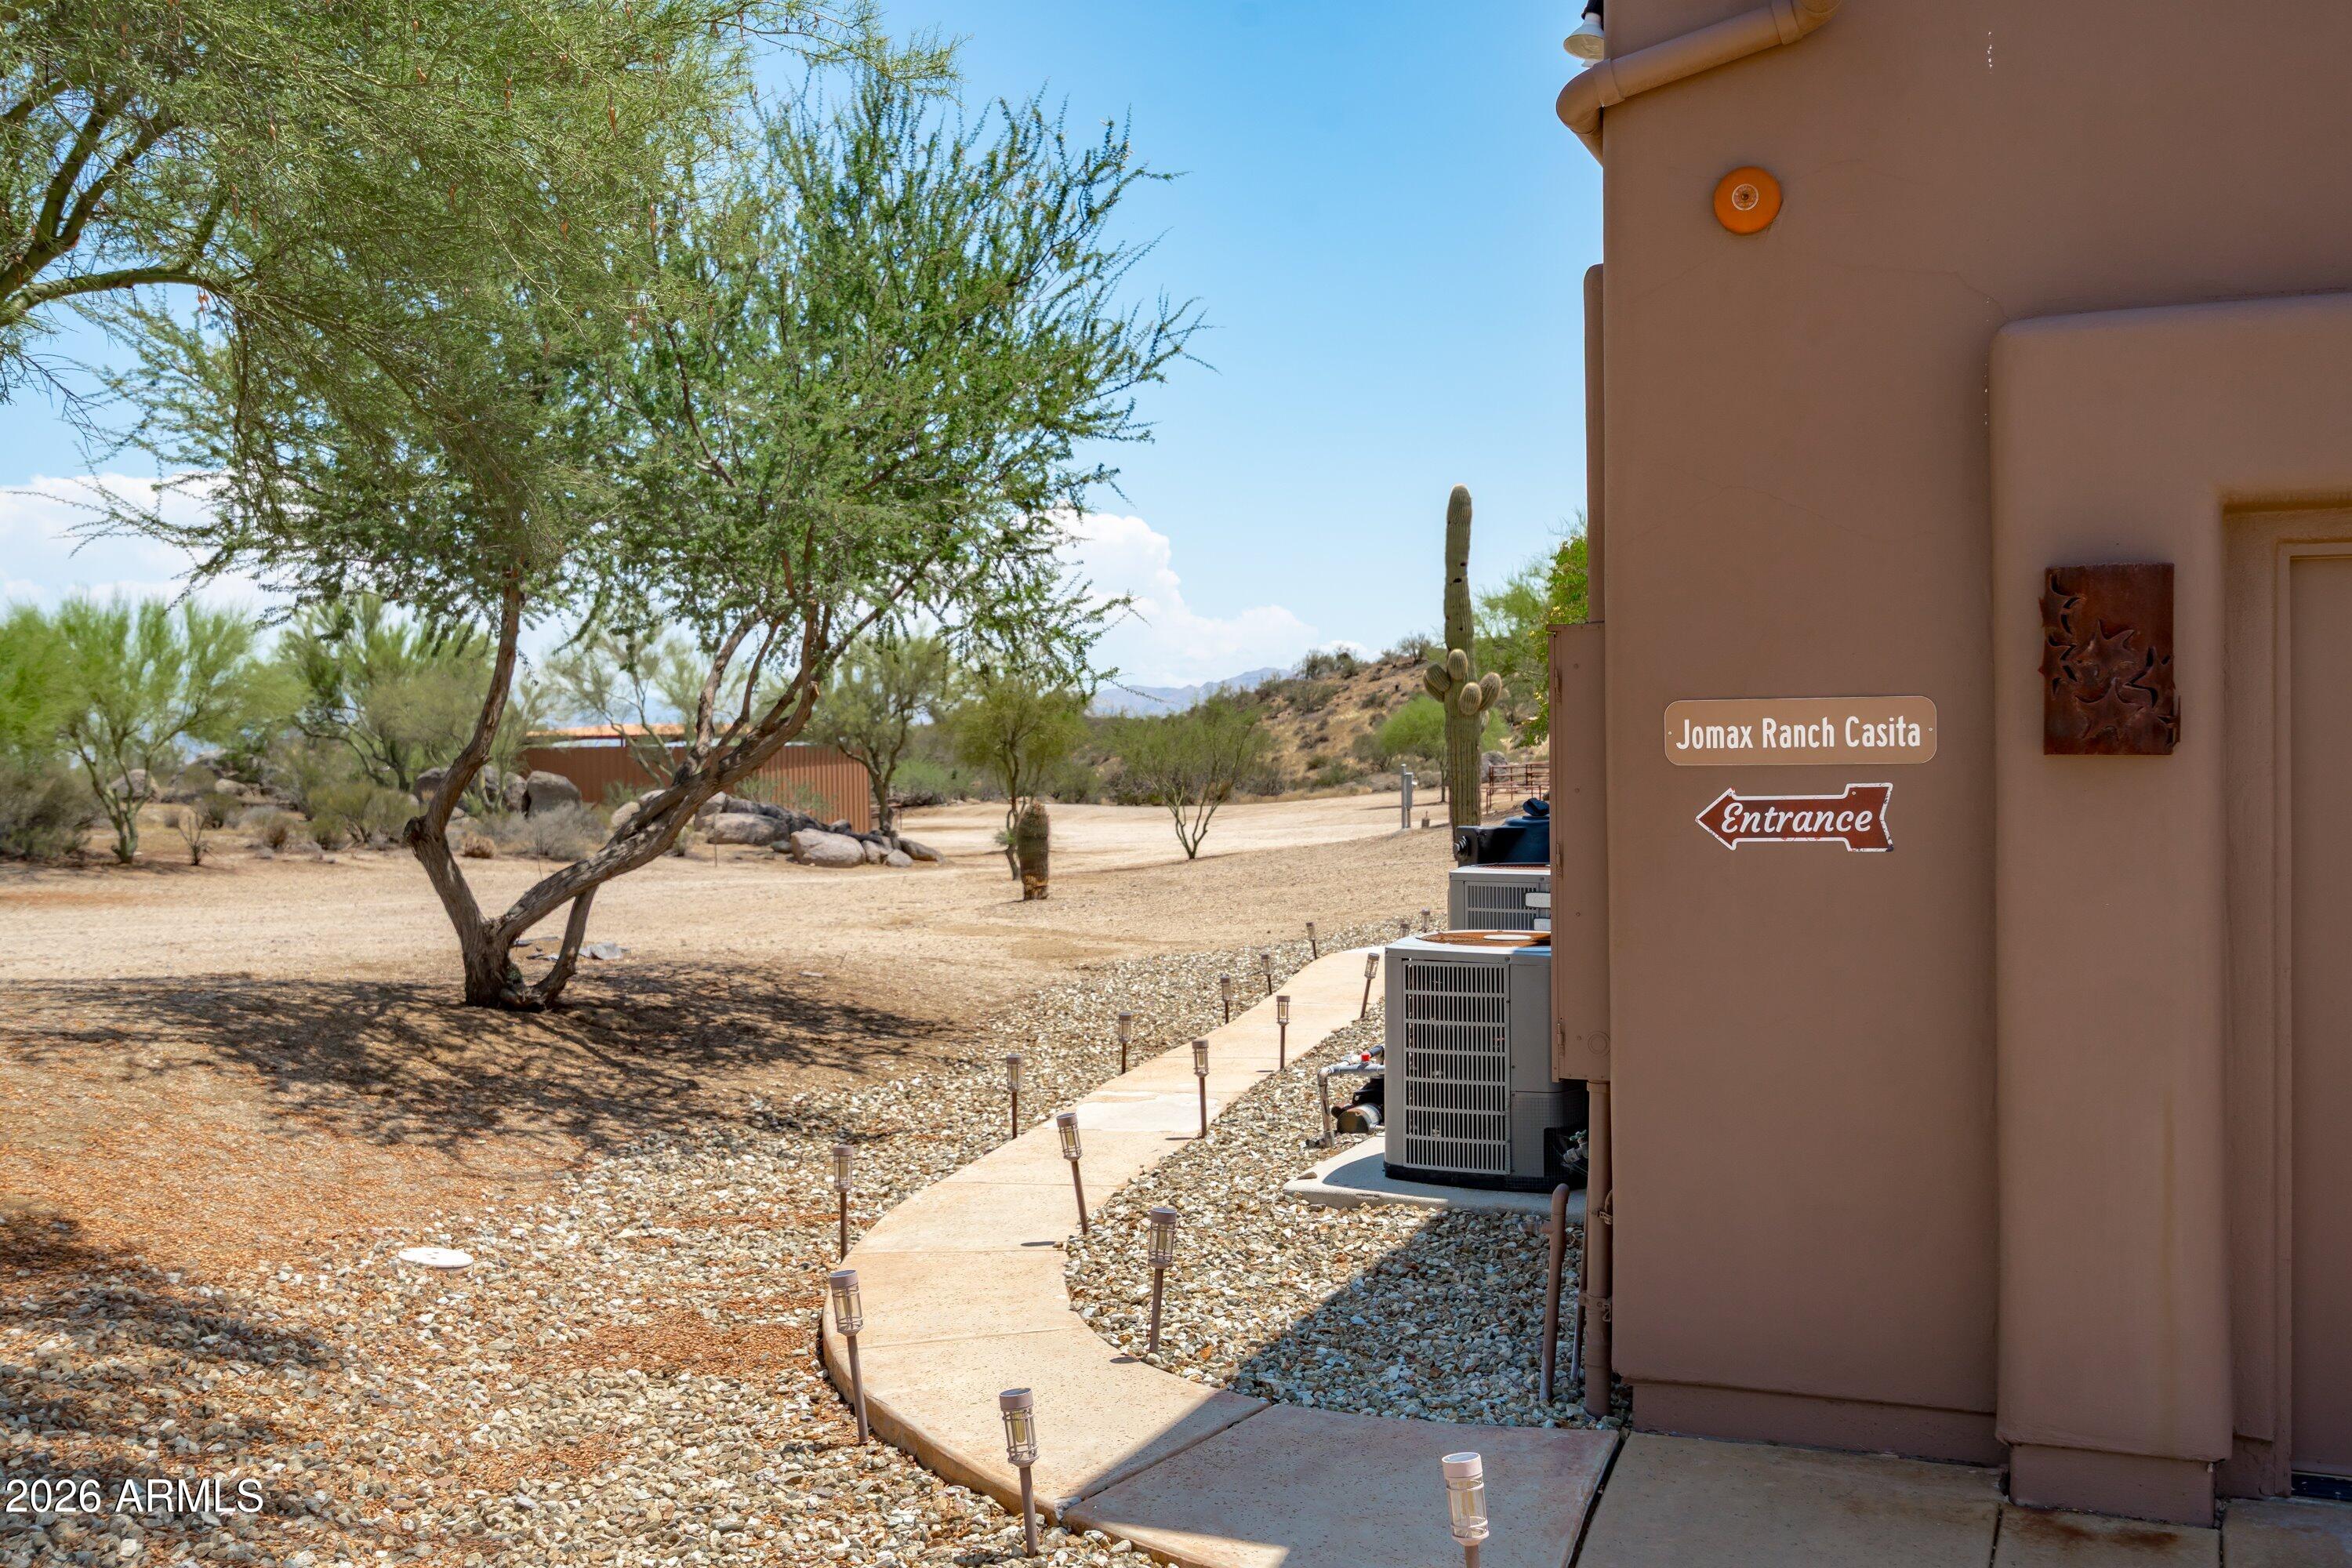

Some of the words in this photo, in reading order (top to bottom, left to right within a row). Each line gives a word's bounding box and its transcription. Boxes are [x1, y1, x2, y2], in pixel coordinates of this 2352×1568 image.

[1675, 719, 1753, 750] Jomax
[1762, 717, 1835, 748] Ranch
[1846, 716, 1921, 748] Casita
[1721, 802, 1873, 833] Entrance
